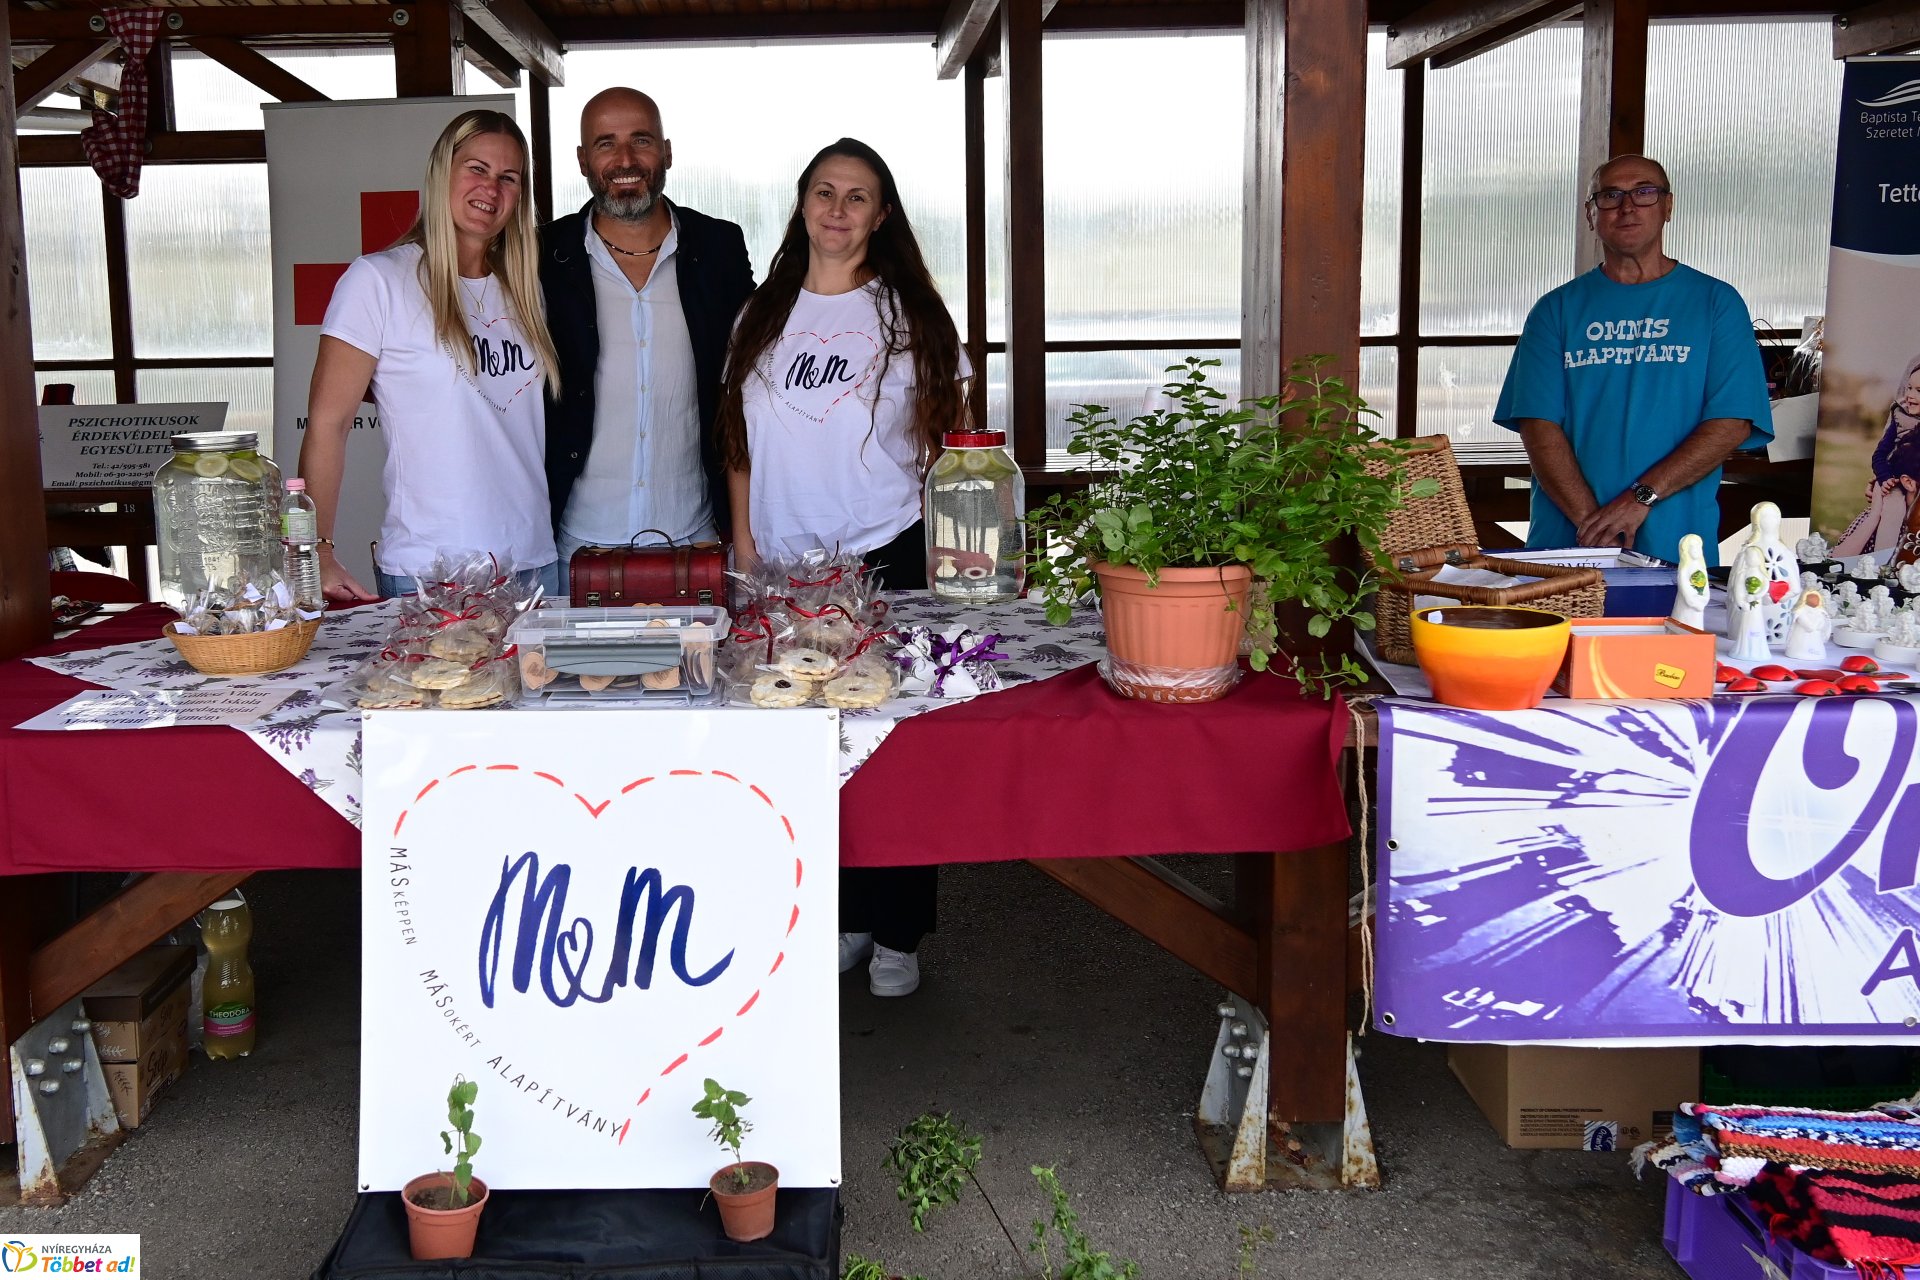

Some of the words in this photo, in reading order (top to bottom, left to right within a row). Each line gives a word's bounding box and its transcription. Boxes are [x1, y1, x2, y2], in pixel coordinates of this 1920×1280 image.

[1860, 112, 1907, 125] Baptista
[1866, 126, 1913, 139] Szeretet
[1878, 183, 1920, 203] Tett
[1586, 317, 1670, 341] OMNIS
[68, 415, 200, 428] PSZICHOTIKUSOK
[75, 471, 103, 479] Mobil:
[124, 503, 136, 513] 18
[209, 1007, 250, 1019] THEODORA
[486, 1054, 623, 1138] ALAPÍTVÁNY
